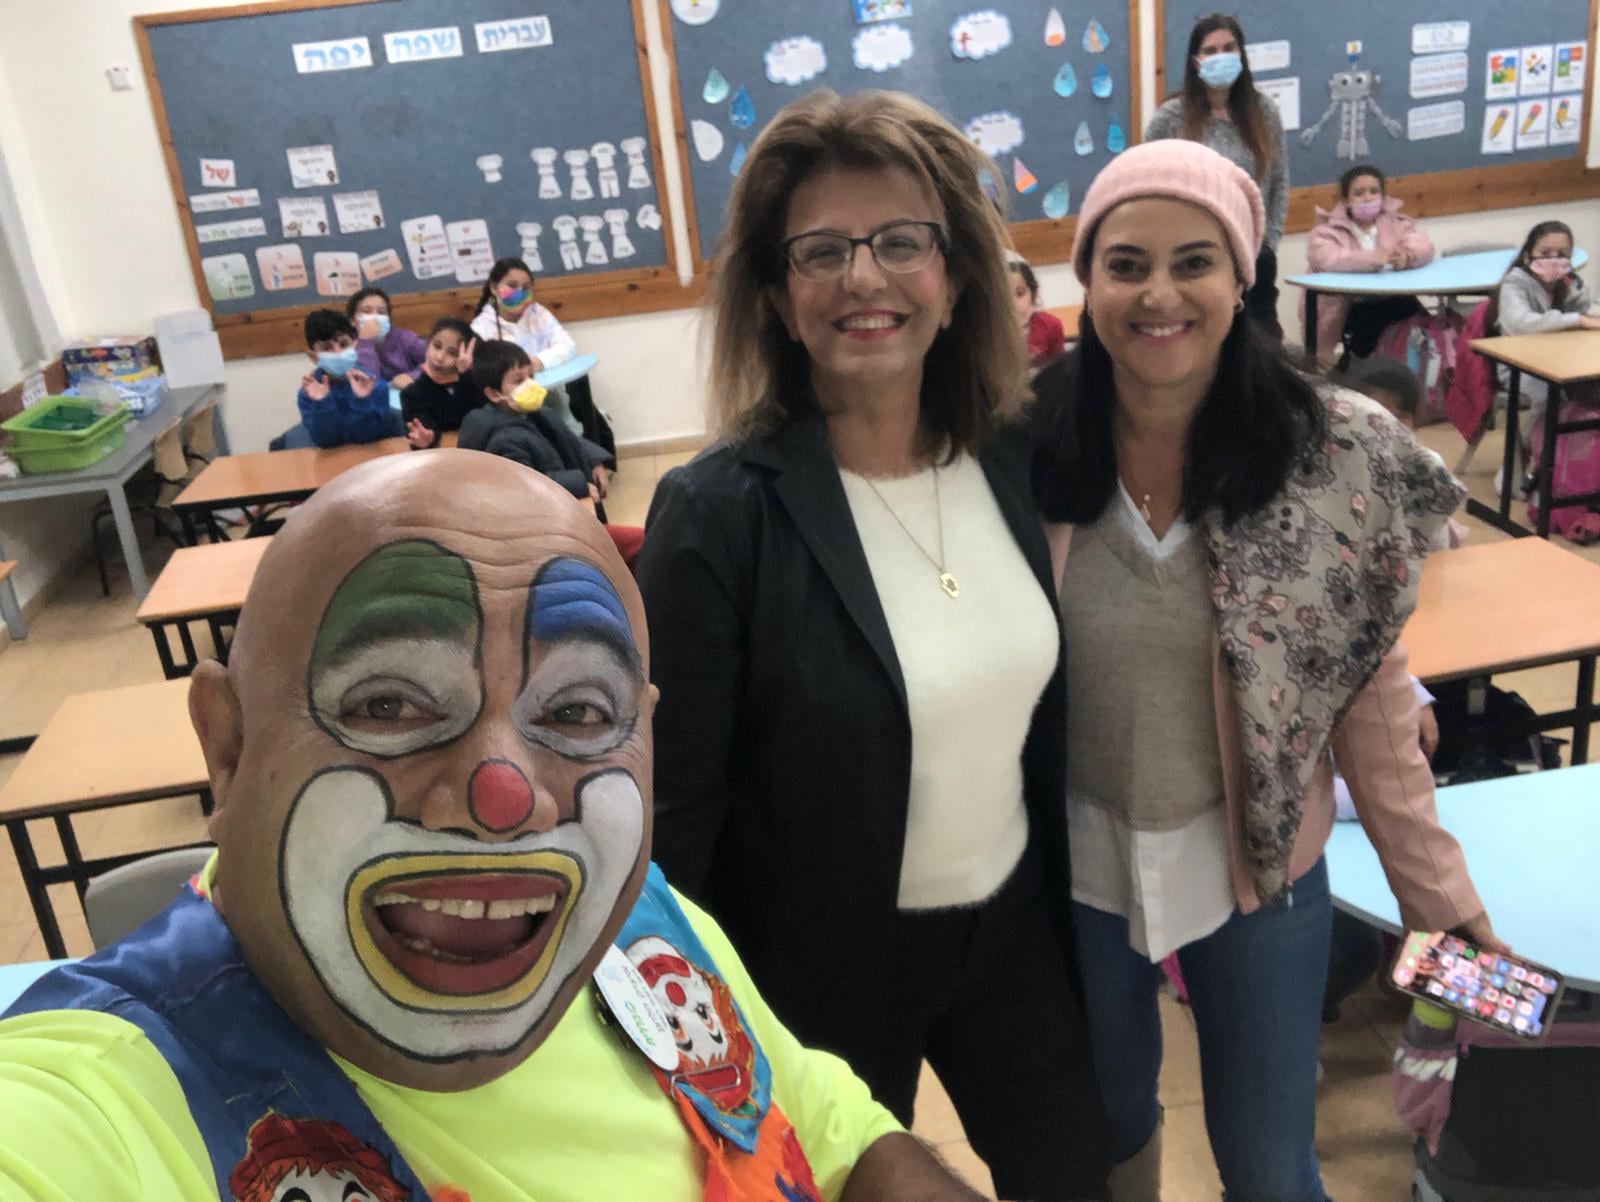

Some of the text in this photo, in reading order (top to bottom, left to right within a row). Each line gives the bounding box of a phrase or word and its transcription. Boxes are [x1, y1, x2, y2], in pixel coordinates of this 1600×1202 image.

[303, 21, 546, 68] עברית שפה יפה
[205, 162, 230, 183] של
